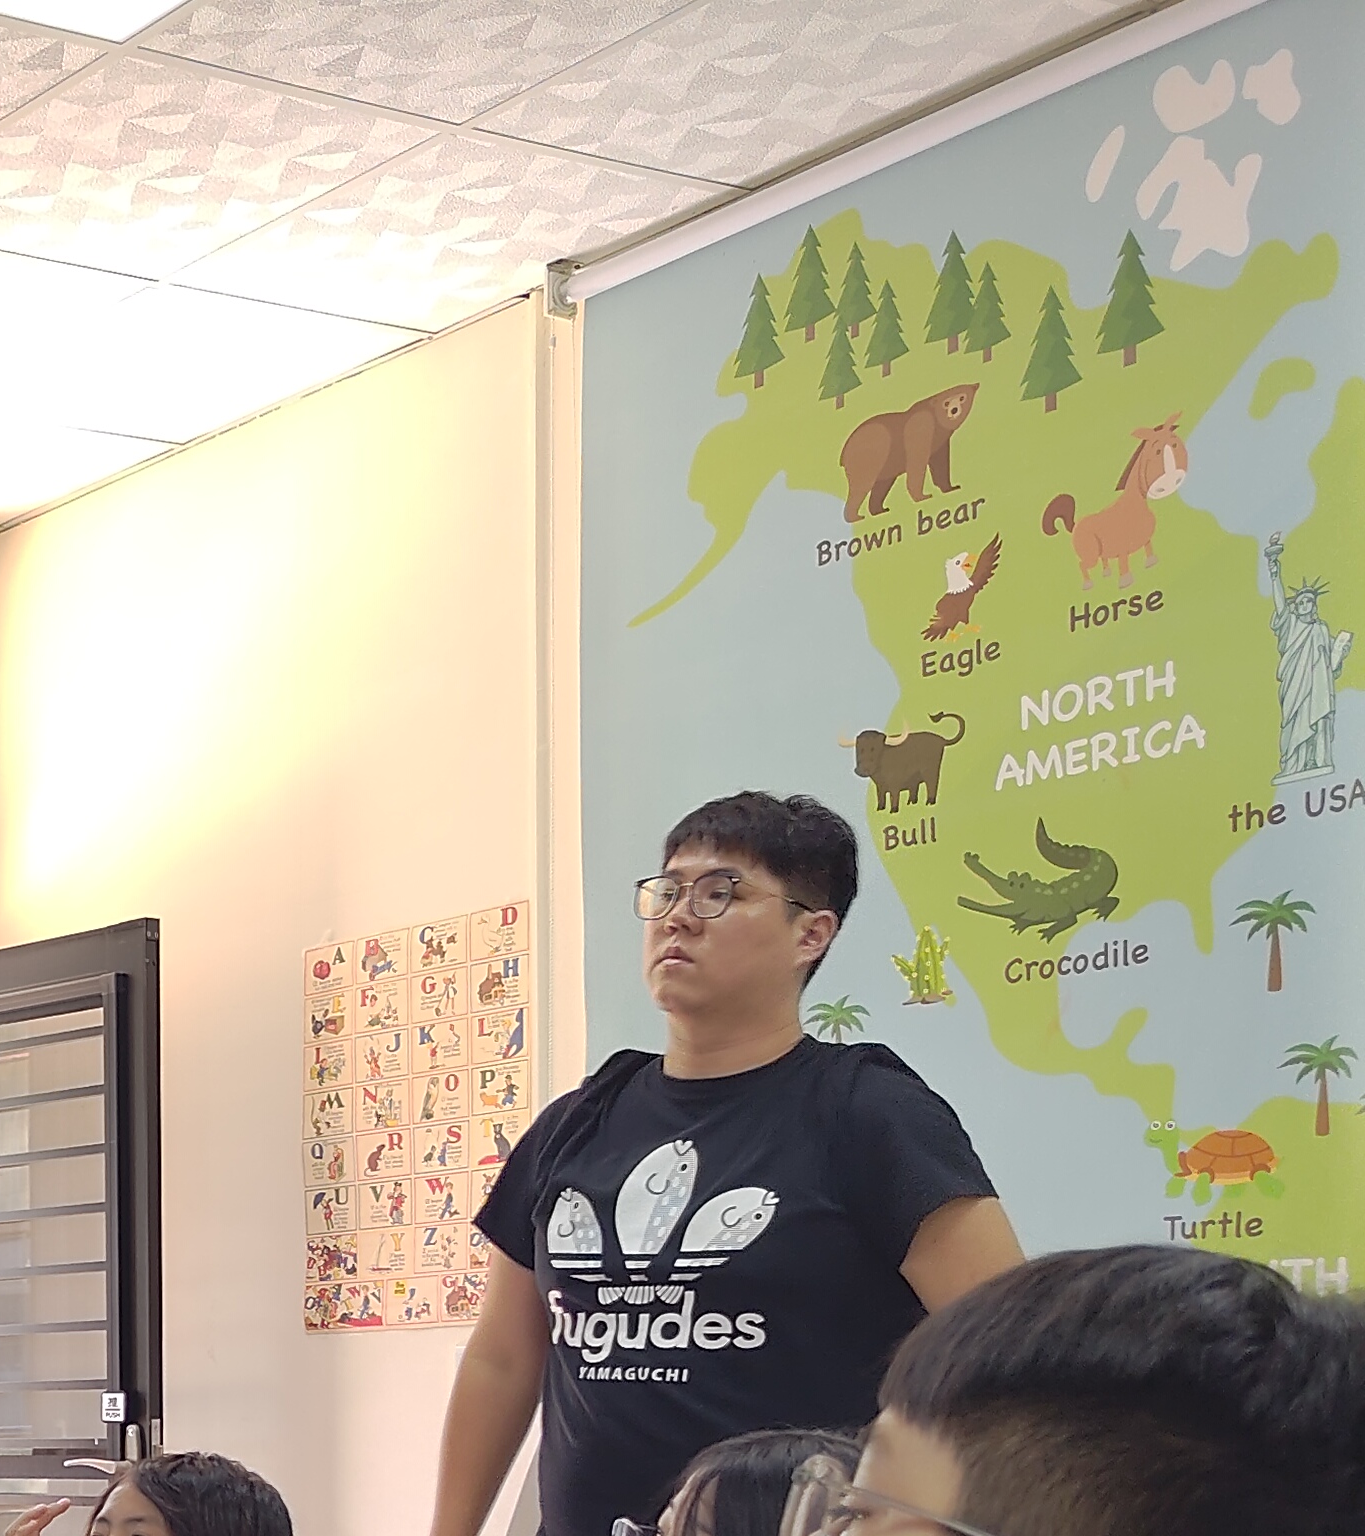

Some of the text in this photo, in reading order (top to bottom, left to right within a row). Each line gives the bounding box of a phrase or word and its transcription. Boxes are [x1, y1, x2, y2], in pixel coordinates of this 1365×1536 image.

[816, 495, 986, 567] Brown bear
[1069, 587, 1165, 633] Horse
[921, 638, 1002, 679] Eagle
[1019, 660, 1177, 732] NORTH
[995, 713, 1207, 793] AMERICA
[1228, 779, 1365, 832] the USA
[883, 818, 937, 851] Bull
[1004, 939, 1150, 984] Crocodile
[1163, 1212, 1265, 1241] Turtle
[547, 1287, 767, 1363] fugudes
[578, 1366, 689, 1383] YAMAGUCHI
